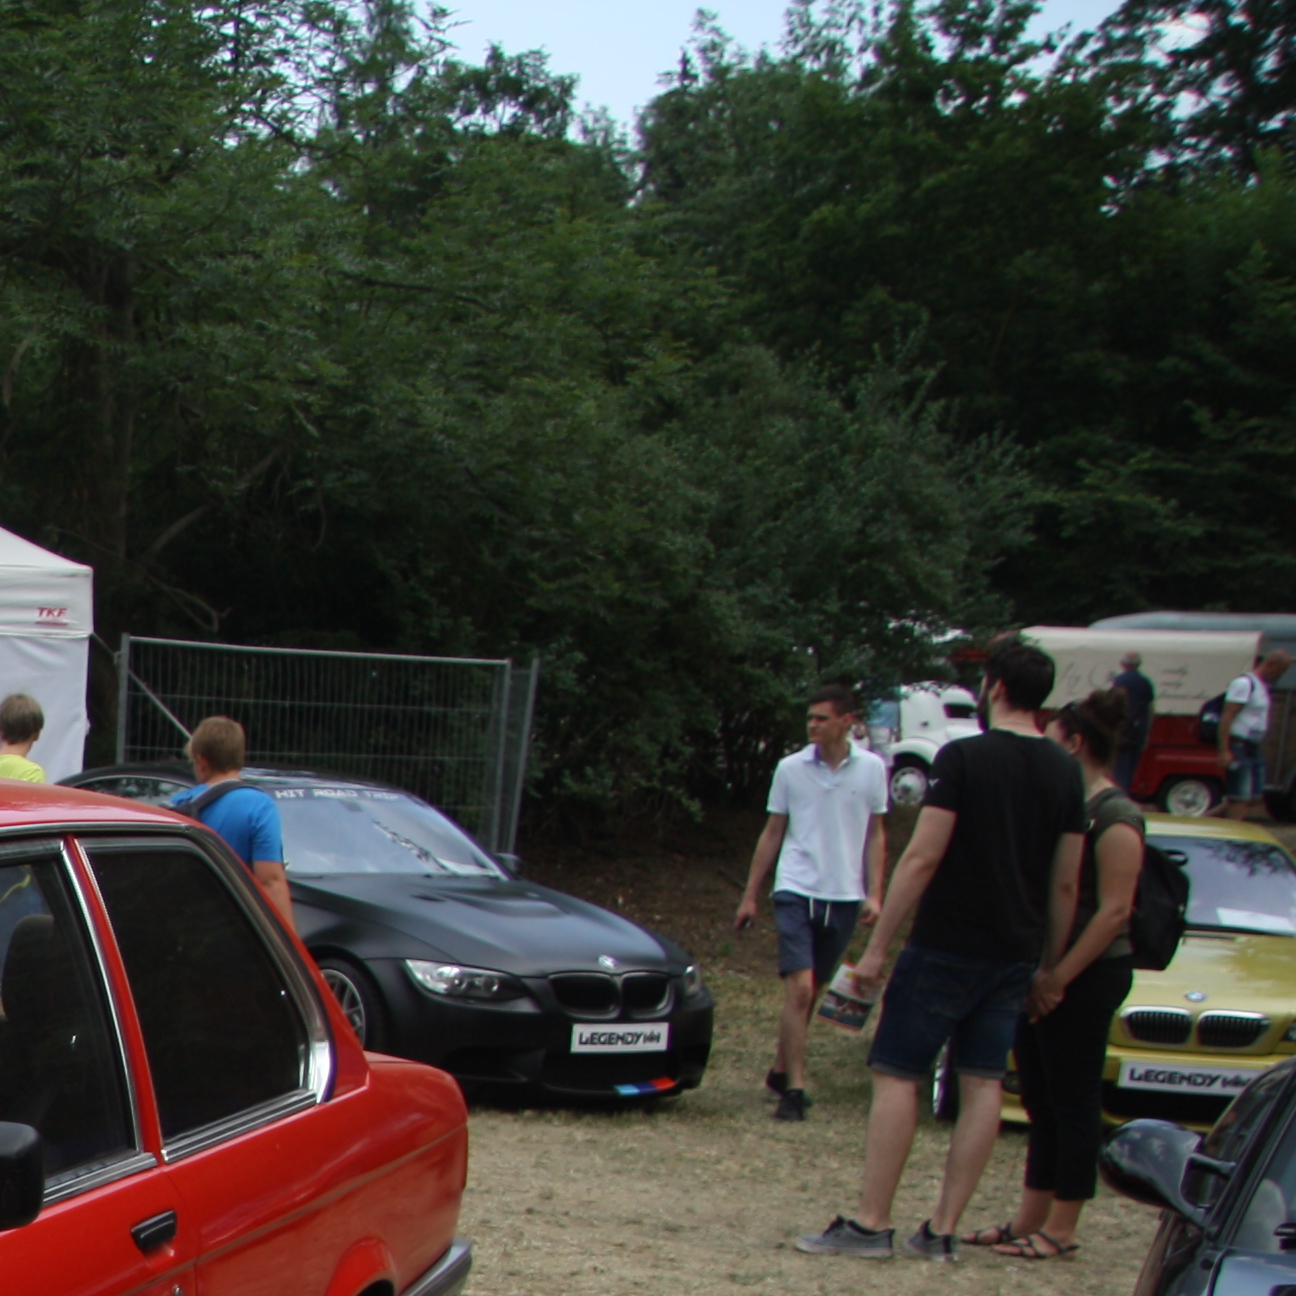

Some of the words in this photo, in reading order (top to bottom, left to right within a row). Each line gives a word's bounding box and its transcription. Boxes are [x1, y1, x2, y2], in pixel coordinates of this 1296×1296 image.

[37, 606, 68, 618] TKF
[274, 788, 305, 799] HIT
[312, 788, 358, 798] ROAD
[578, 1031, 643, 1046] LEGENDY
[1128, 1067, 1222, 1088] LEGENDY
